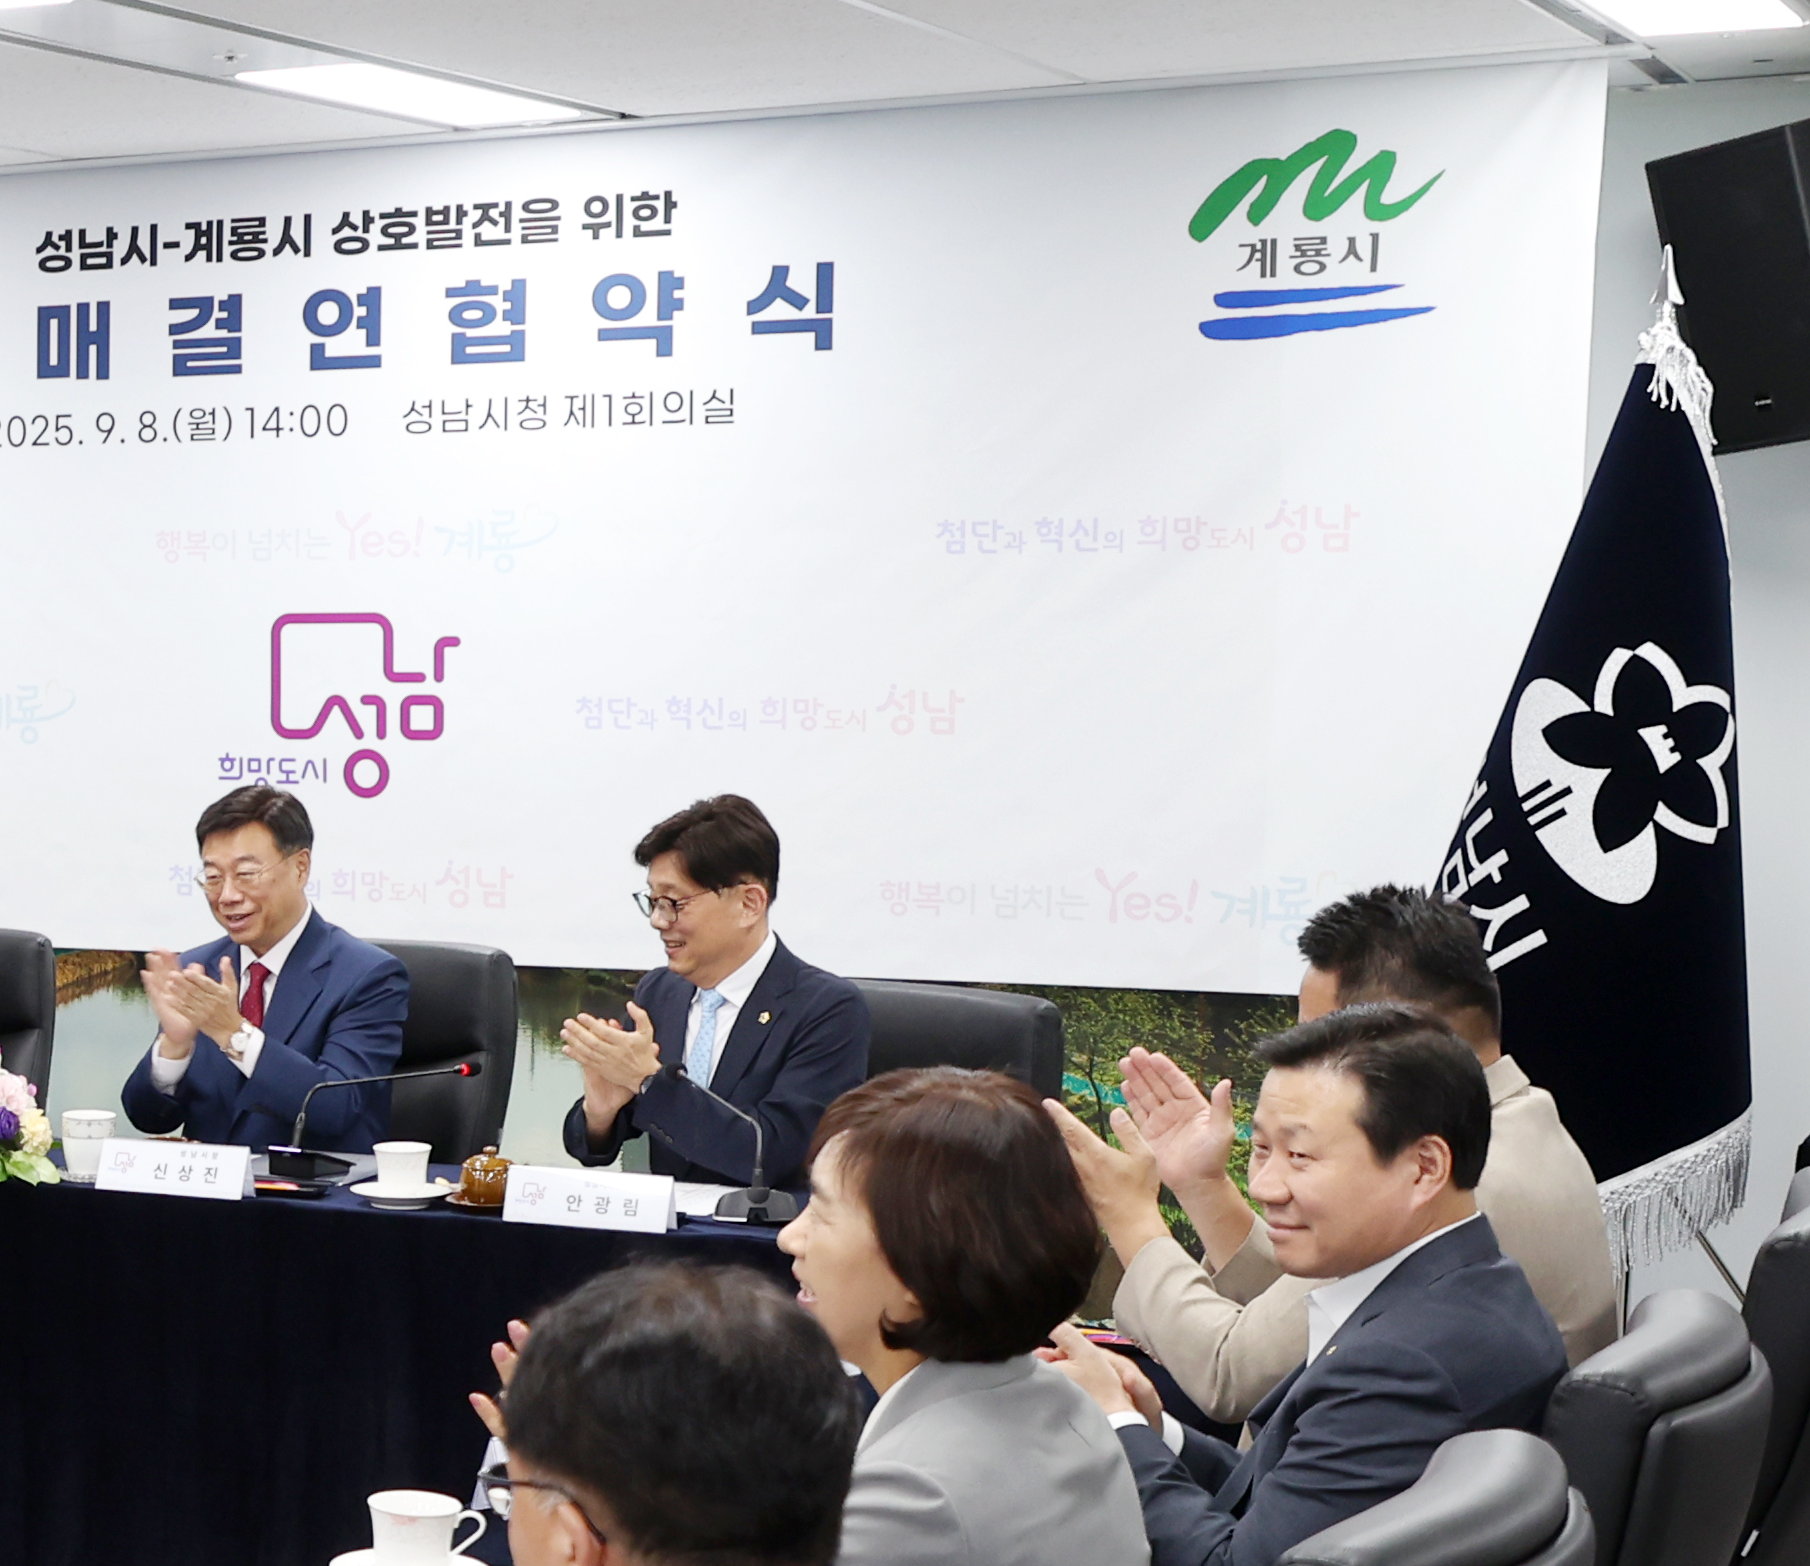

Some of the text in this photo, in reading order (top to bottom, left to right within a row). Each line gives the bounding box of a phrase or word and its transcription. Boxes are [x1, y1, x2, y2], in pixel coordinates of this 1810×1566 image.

[35, 189, 678, 273] 성남시-계룡시 상호발전을 위한
[1236, 232, 1381, 279] 계룡시
[245, 403, 348, 440] 14:00
[401, 395, 550, 435] 성남시청
[563, 387, 737, 430] 제1회의실
[155, 508, 524, 574] 행복이 넘치는 Yes! 계룡
[934, 498, 1361, 556] 첨단과 혁신의 희망도시 성남
[217, 611, 462, 799] 희망도시 성남
[575, 683, 966, 737] 첨단과 혁신의 희망도시 성남
[330, 867, 428, 905] 희망도시
[434, 858, 515, 910] 성남
[1440, 779, 1548, 973] 남시
[879, 867, 1314, 947] 행복이 넘치는 Yes! 계룡
[152, 1163, 219, 1185] 신상진
[565, 1193, 640, 1217] 안광림
